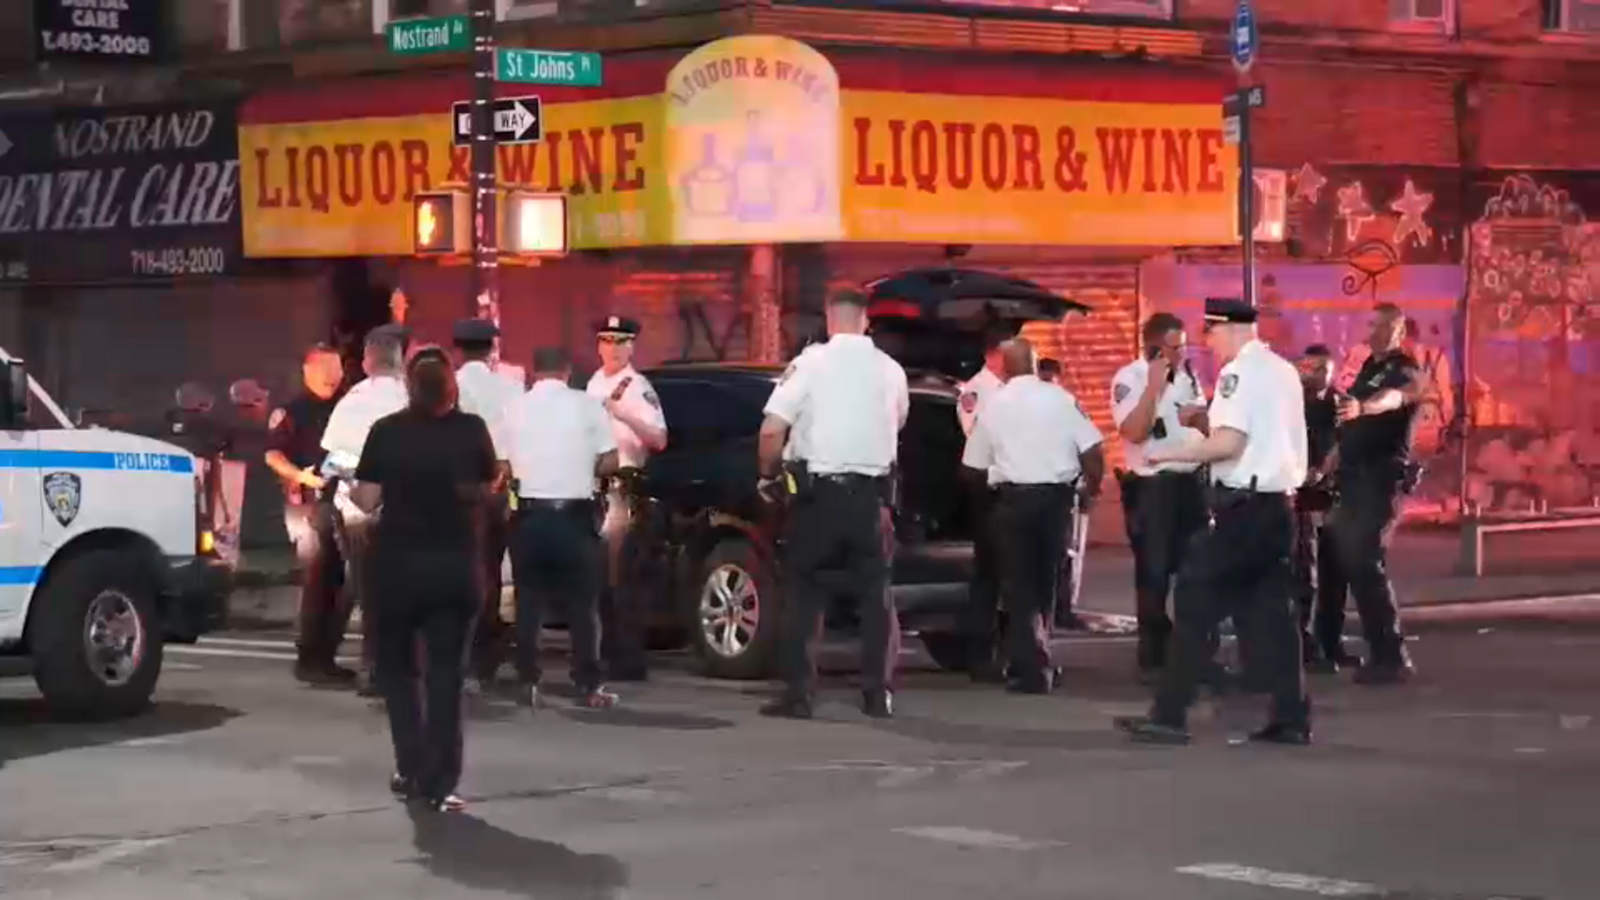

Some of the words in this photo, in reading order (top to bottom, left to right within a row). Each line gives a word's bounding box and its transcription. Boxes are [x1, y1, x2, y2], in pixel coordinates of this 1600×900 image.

[72, 9, 119, 29] CARE
[393, 20, 449, 50] Nostrand
[507, 53, 523, 77] St
[530, 53, 575, 80] Johns
[672, 57, 749, 107] LIQUOR
[754, 58, 768, 77] &
[55, 110, 215, 158] NOSTRAND
[501, 112, 526, 128] WAY
[255, 139, 431, 213] LIQUOR
[499, 122, 646, 196] WINE
[854, 117, 1044, 194] LIQUOR
[1055, 125, 1087, 192] &
[1095, 127, 1224, 194] WINE
[130, 159, 239, 228] CARE
[131, 246, 224, 274] 718-493-2000
[116, 453, 168, 471] POLICE
